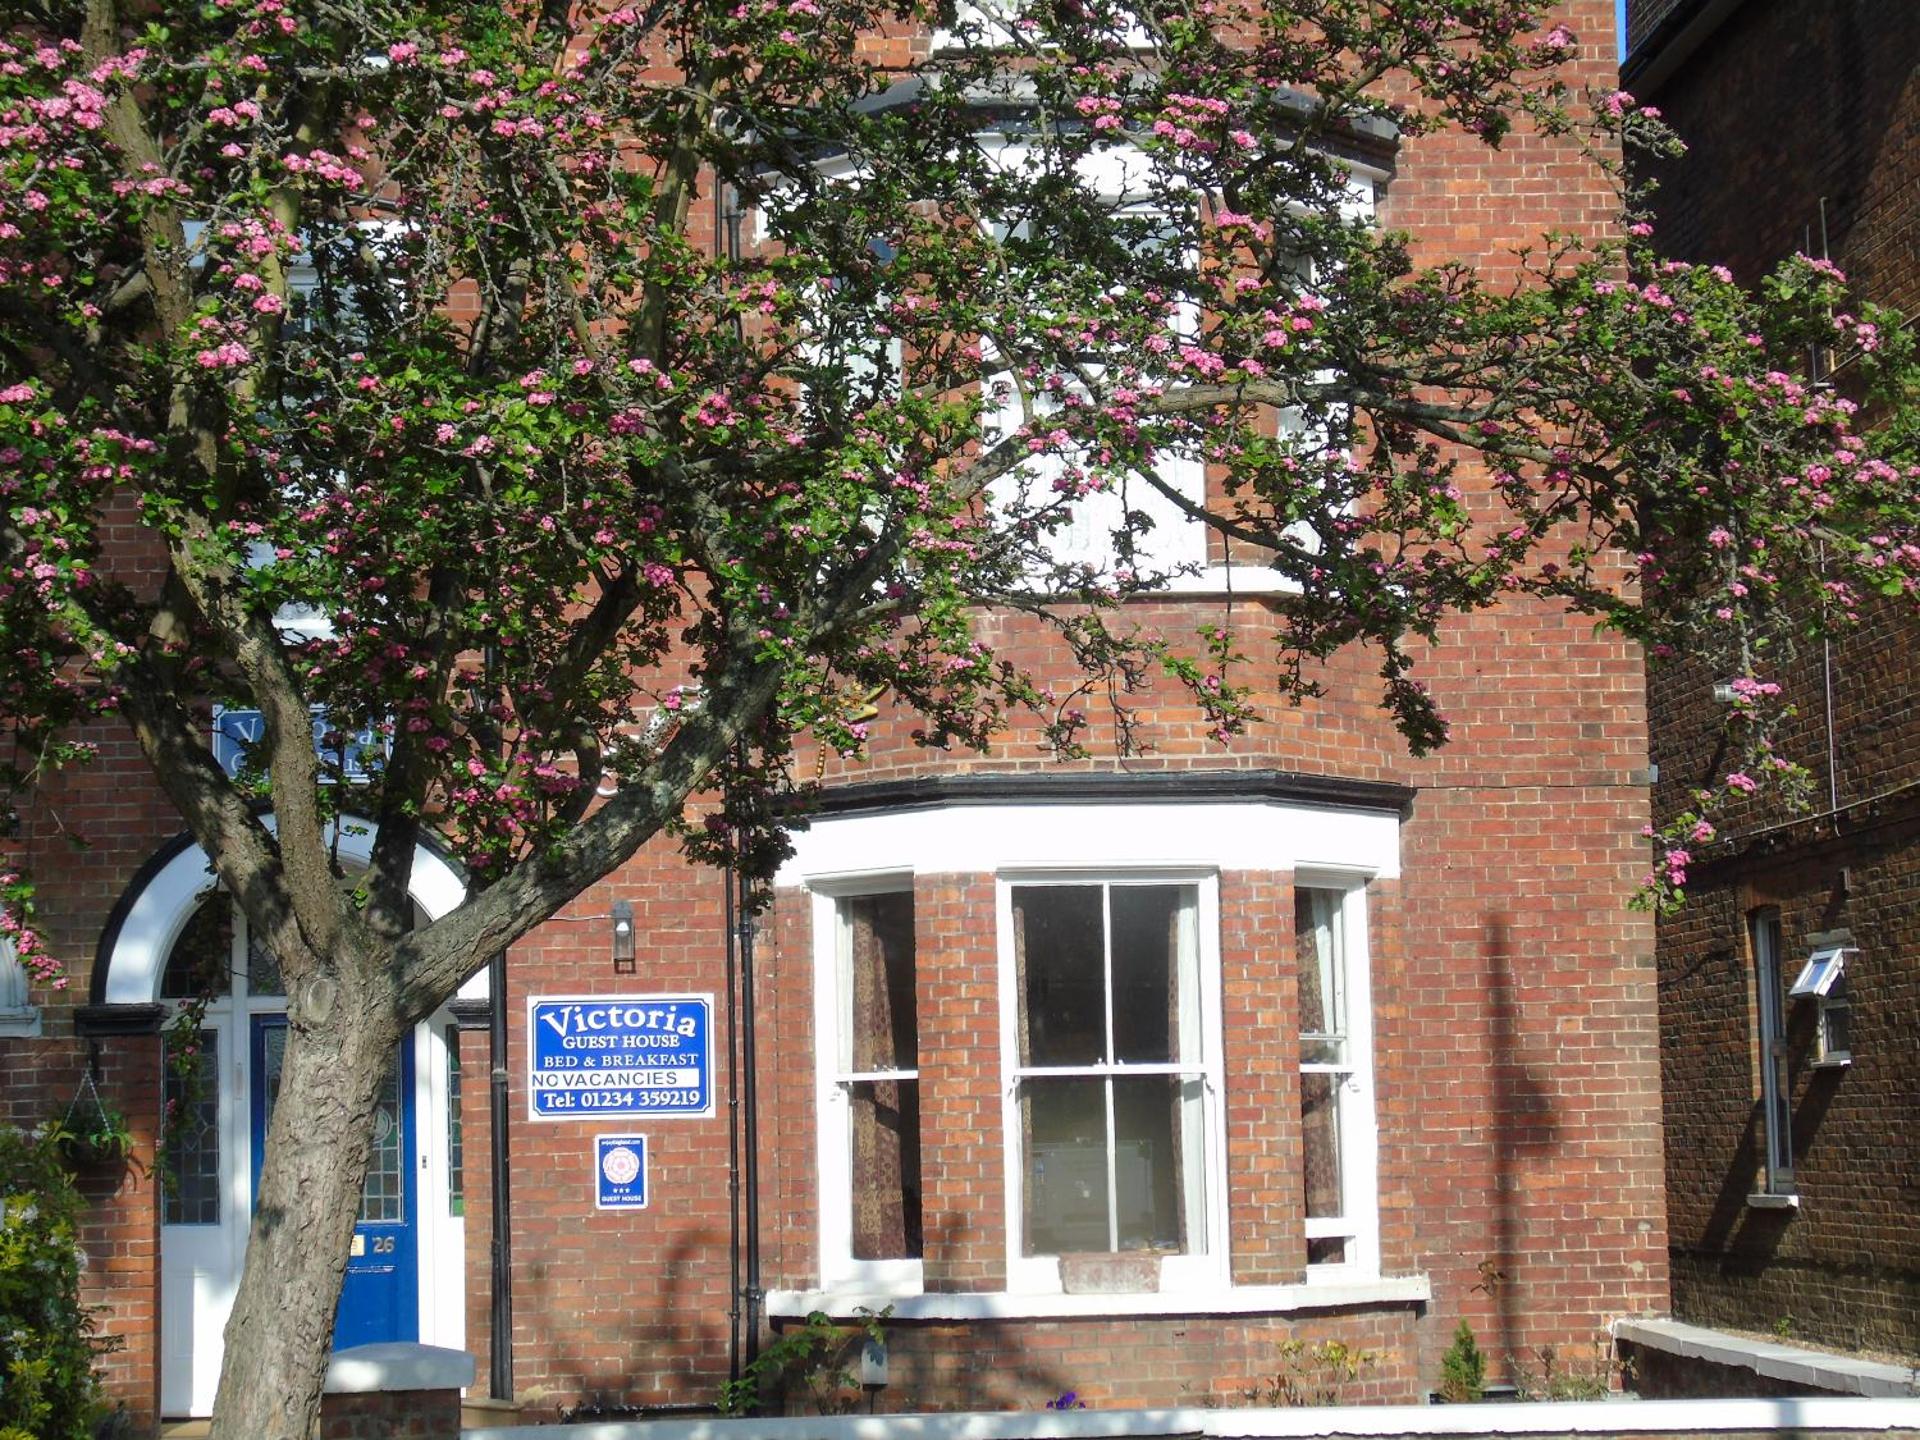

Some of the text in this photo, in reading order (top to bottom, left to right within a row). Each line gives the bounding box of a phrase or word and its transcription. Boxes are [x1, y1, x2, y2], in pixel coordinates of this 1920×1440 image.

[540, 1005, 697, 1038] Victoria
[562, 1033, 681, 1050] GUEST HOUSE
[544, 1053, 699, 1068] BED & BREAKFAST
[532, 1071, 678, 1088] NO VACANCIES
[543, 1090, 701, 1109] Tel: 01234 359219
[621, 1194, 642, 1202] HOUSE
[371, 1235, 395, 1254] 26
